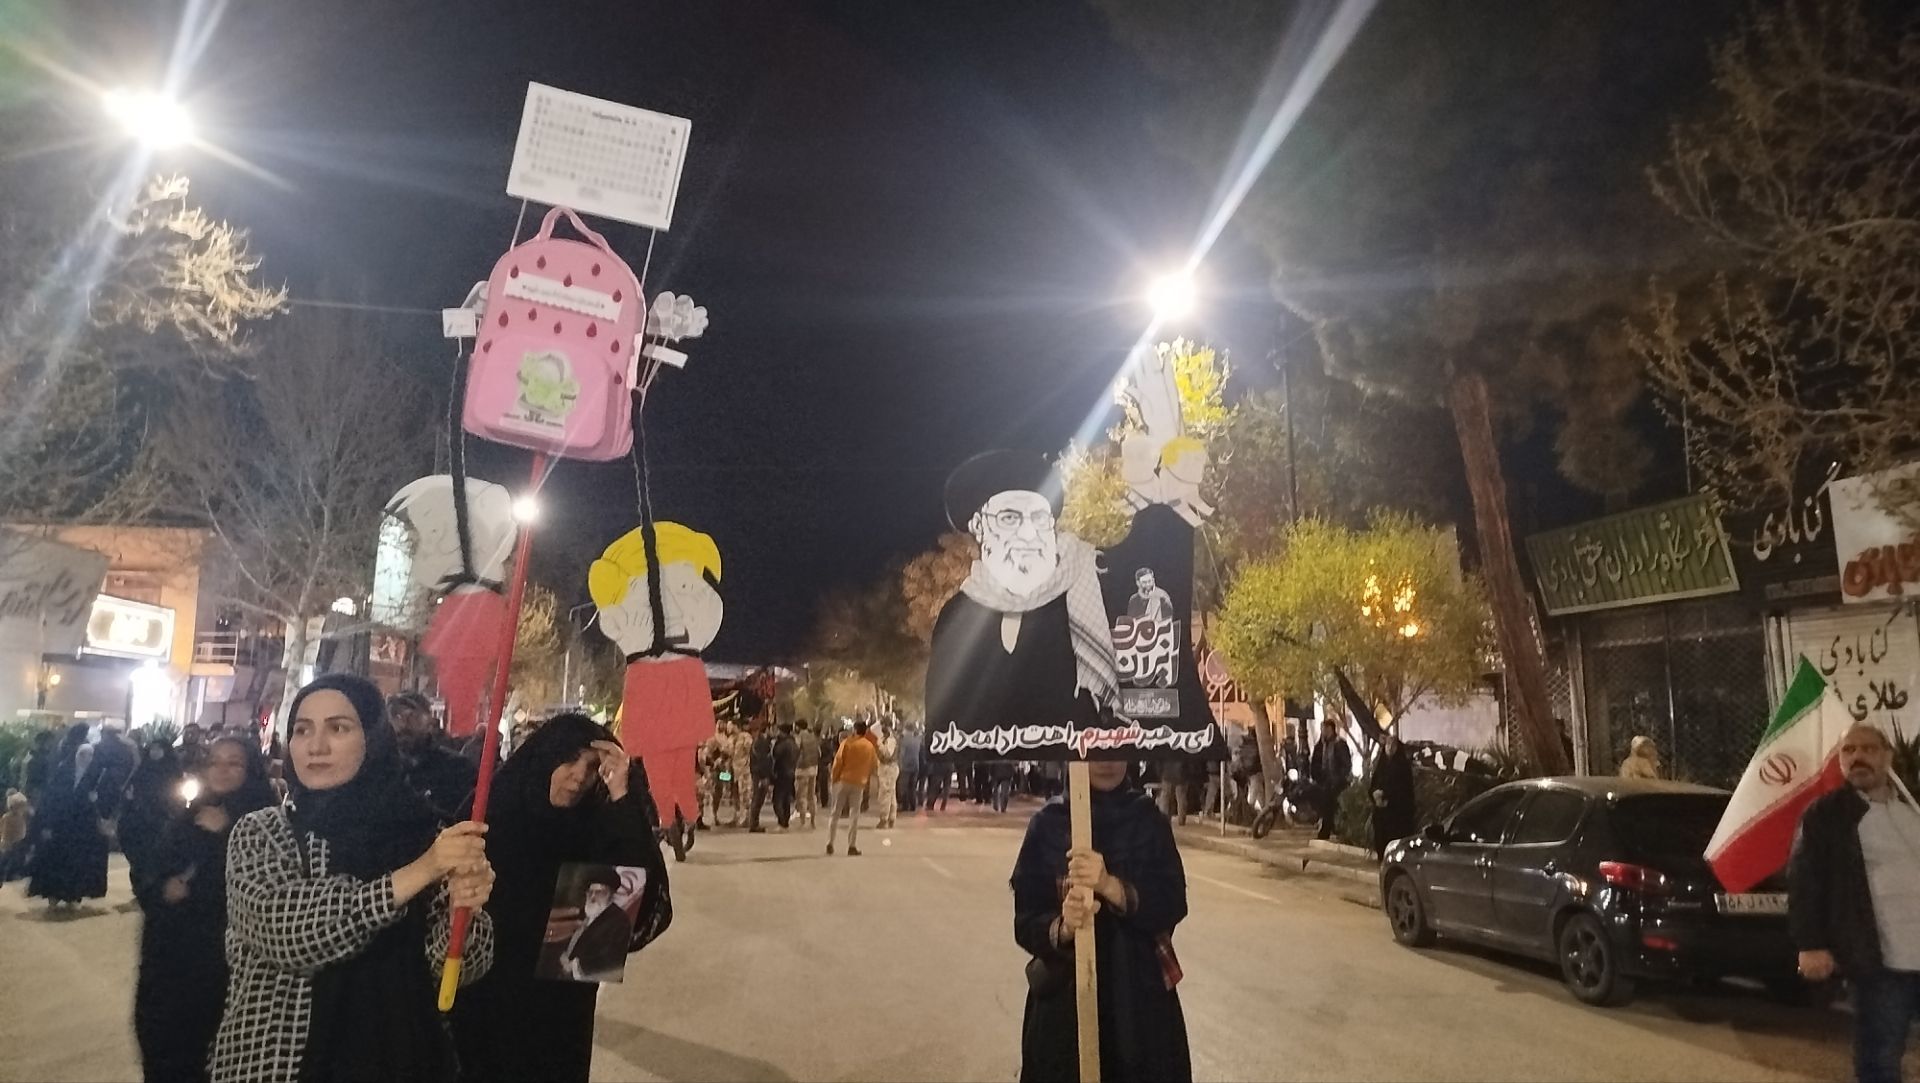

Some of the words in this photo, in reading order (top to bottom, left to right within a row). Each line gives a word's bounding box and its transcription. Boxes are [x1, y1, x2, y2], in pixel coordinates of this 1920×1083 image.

[1605, 528, 1667, 586] برادران
[1117, 652, 1180, 688] ایران
[931, 721, 967, 755] دارد
[971, 724, 1018, 756] ادامه
[1020, 721, 1078, 750] راهت
[1079, 720, 1140, 759] شهیدم
[1139, 724, 1182, 750] رهبر
[1184, 723, 1214, 754] ای
